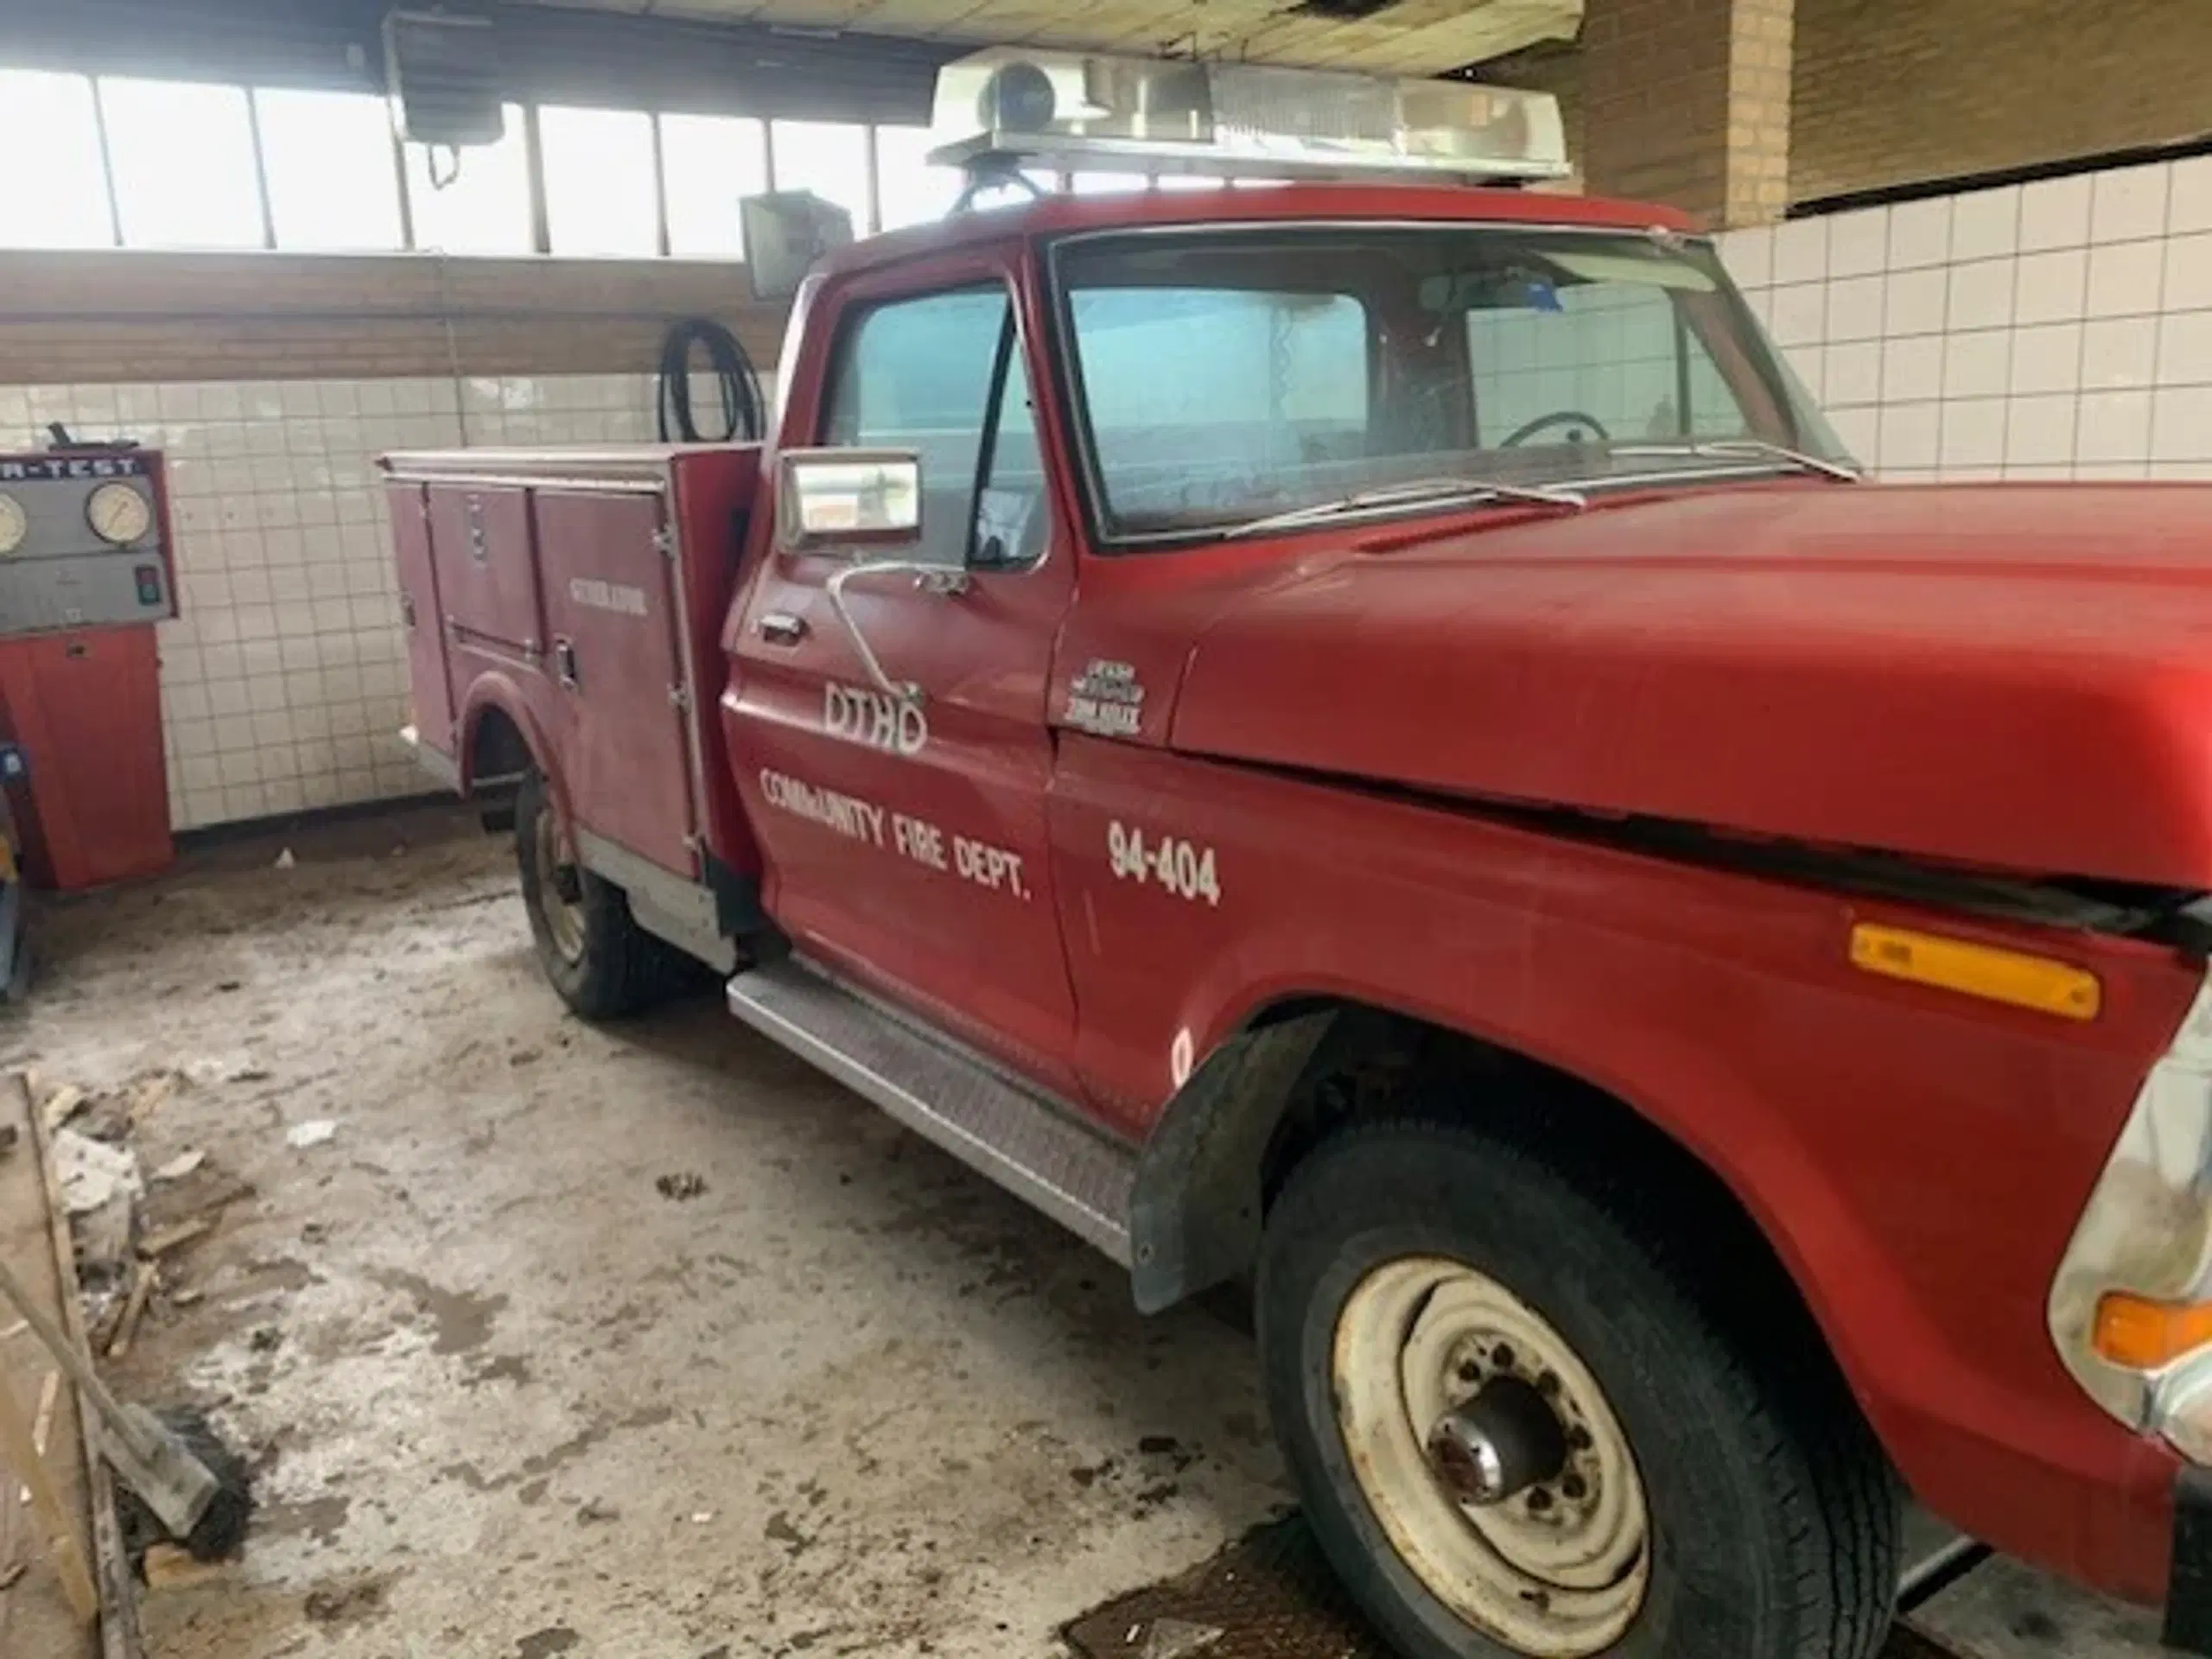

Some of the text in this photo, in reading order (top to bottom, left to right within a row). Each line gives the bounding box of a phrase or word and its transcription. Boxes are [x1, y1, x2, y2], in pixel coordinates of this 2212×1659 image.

[760, 766, 1032, 902] COMMUNITY FIRE DEPT.
[1108, 819, 1222, 906] 94-404
